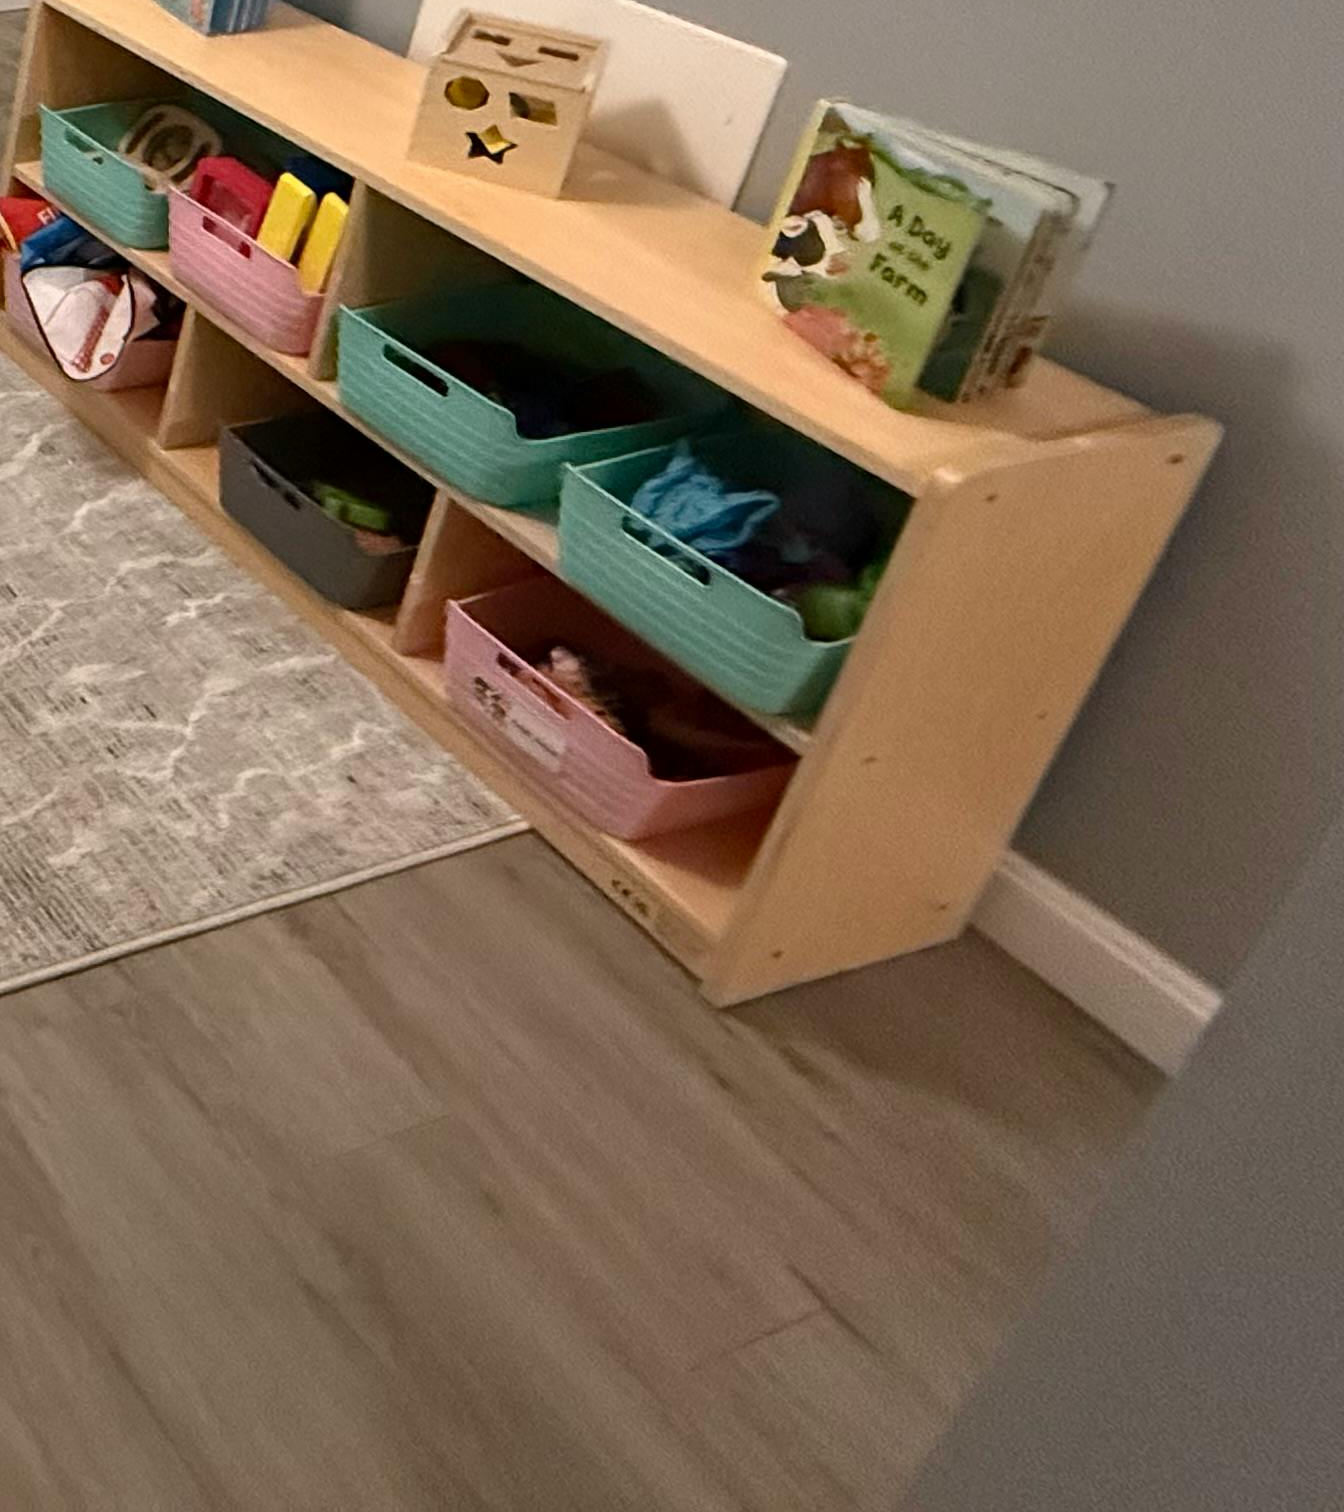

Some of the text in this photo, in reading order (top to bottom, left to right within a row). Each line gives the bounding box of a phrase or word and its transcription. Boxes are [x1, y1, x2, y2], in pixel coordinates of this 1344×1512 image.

[887, 205, 951, 260] A Day
[870, 253, 928, 305] Farm
